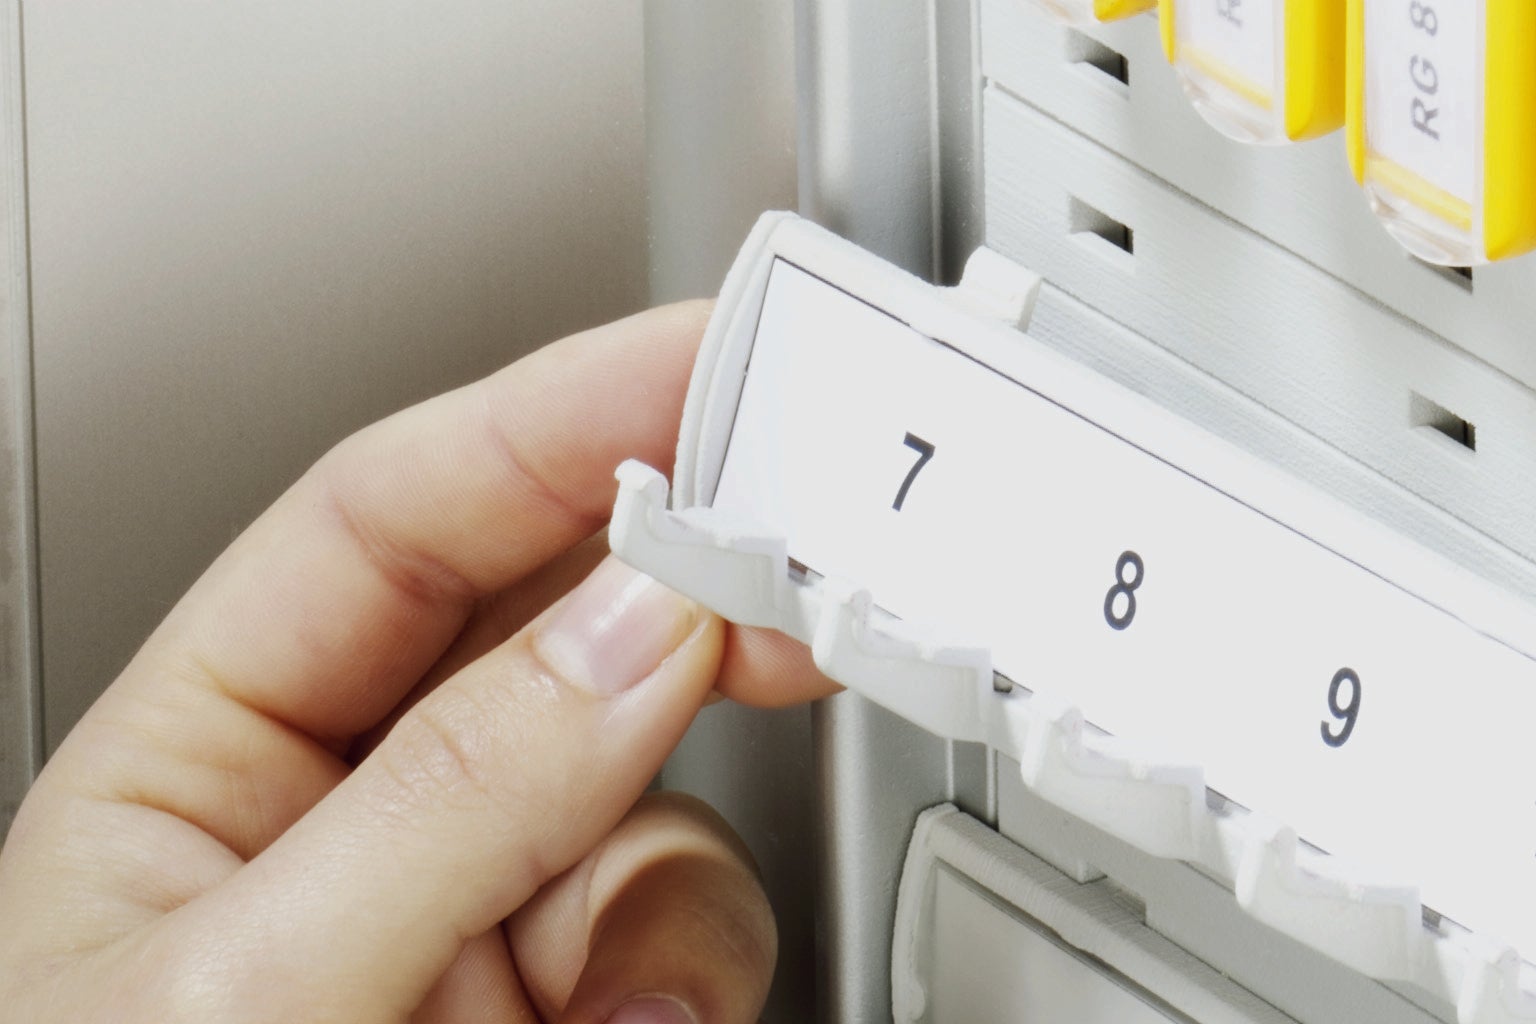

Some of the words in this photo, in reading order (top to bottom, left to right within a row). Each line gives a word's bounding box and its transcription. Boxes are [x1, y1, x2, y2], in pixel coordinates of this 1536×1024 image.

[1410, 55, 1439, 140] RG
[893, 432, 935, 511] 7
[1104, 551, 1144, 630] 8
[1321, 668, 1361, 747] 9
